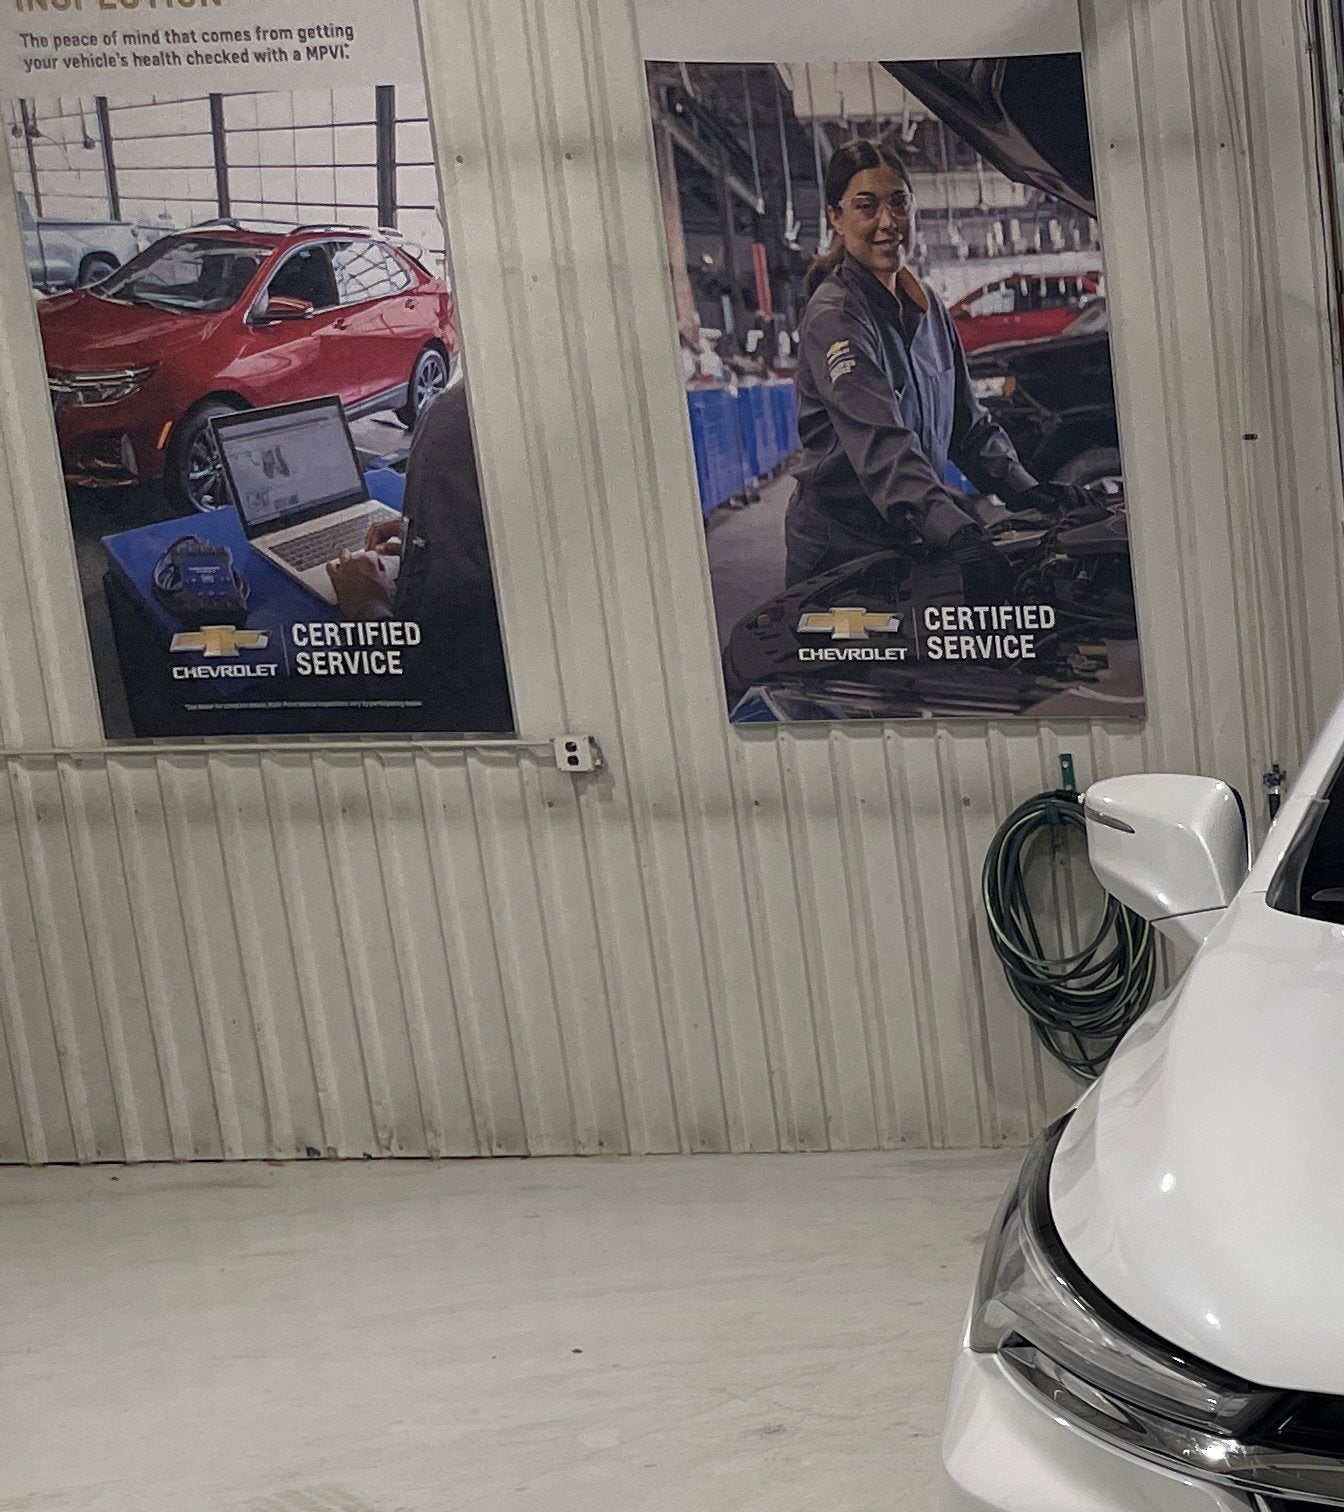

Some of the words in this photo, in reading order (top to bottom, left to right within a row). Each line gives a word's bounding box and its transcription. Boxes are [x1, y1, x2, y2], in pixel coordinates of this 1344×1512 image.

[19, 32, 48, 48] The
[53, 34, 98, 51] peace
[103, 30, 117, 46] of
[123, 29, 160, 45] mind
[165, 28, 197, 44] that
[202, 29, 251, 43] comes
[256, 25, 293, 41] from
[297, 23, 354, 43] getting
[24, 57, 58, 73] your
[63, 52, 129, 69] vehicle's
[133, 51, 182, 66] health
[187, 48, 249, 65] checked
[253, 47, 288, 63] with
[293, 50, 301, 61] a
[924, 605, 1055, 630] CERTIFIED
[292, 621, 421, 646] CERTIFIED
[798, 647, 907, 661] CHEVROLET
[927, 634, 1037, 660] SERVICE
[172, 663, 278, 679] CHEVROLET
[296, 650, 403, 675] SERVICE
